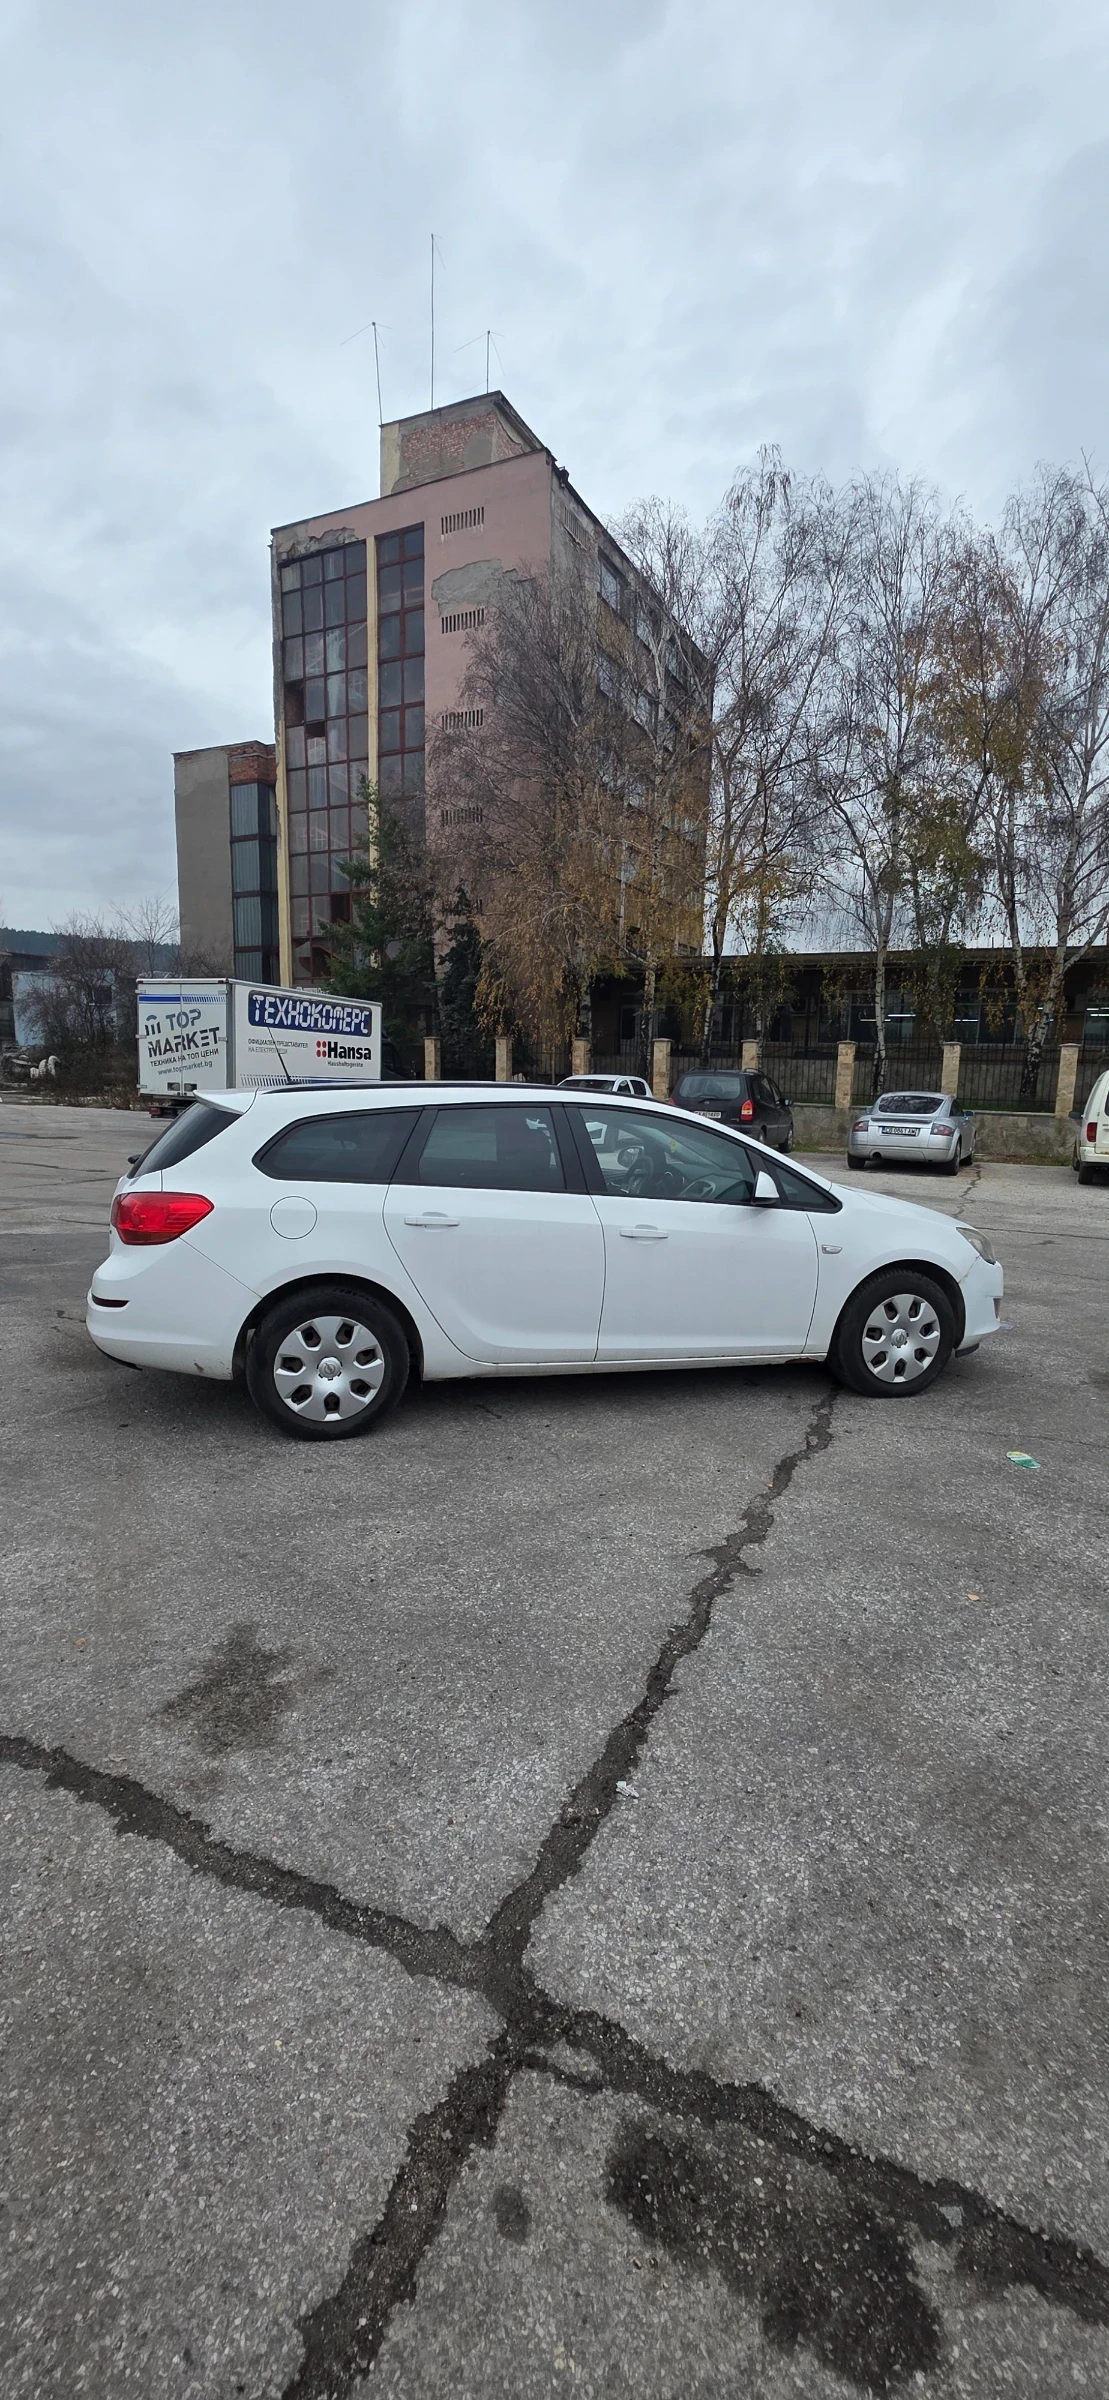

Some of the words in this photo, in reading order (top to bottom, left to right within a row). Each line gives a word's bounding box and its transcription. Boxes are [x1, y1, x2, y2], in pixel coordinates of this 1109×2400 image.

[165, 1008, 202, 1031] TOP
[147, 1026, 220, 1058] MARKET
[327, 1041, 372, 1061] Hansa
[150, 1057, 177, 1068] ТЕХНИКА
[177, 1055, 187, 1063] НА
[187, 1051, 200, 1060] ТОП
[200, 1048, 219, 1058] ЦЕНИ
[157, 1060, 213, 1076] www.topmarket.bg
